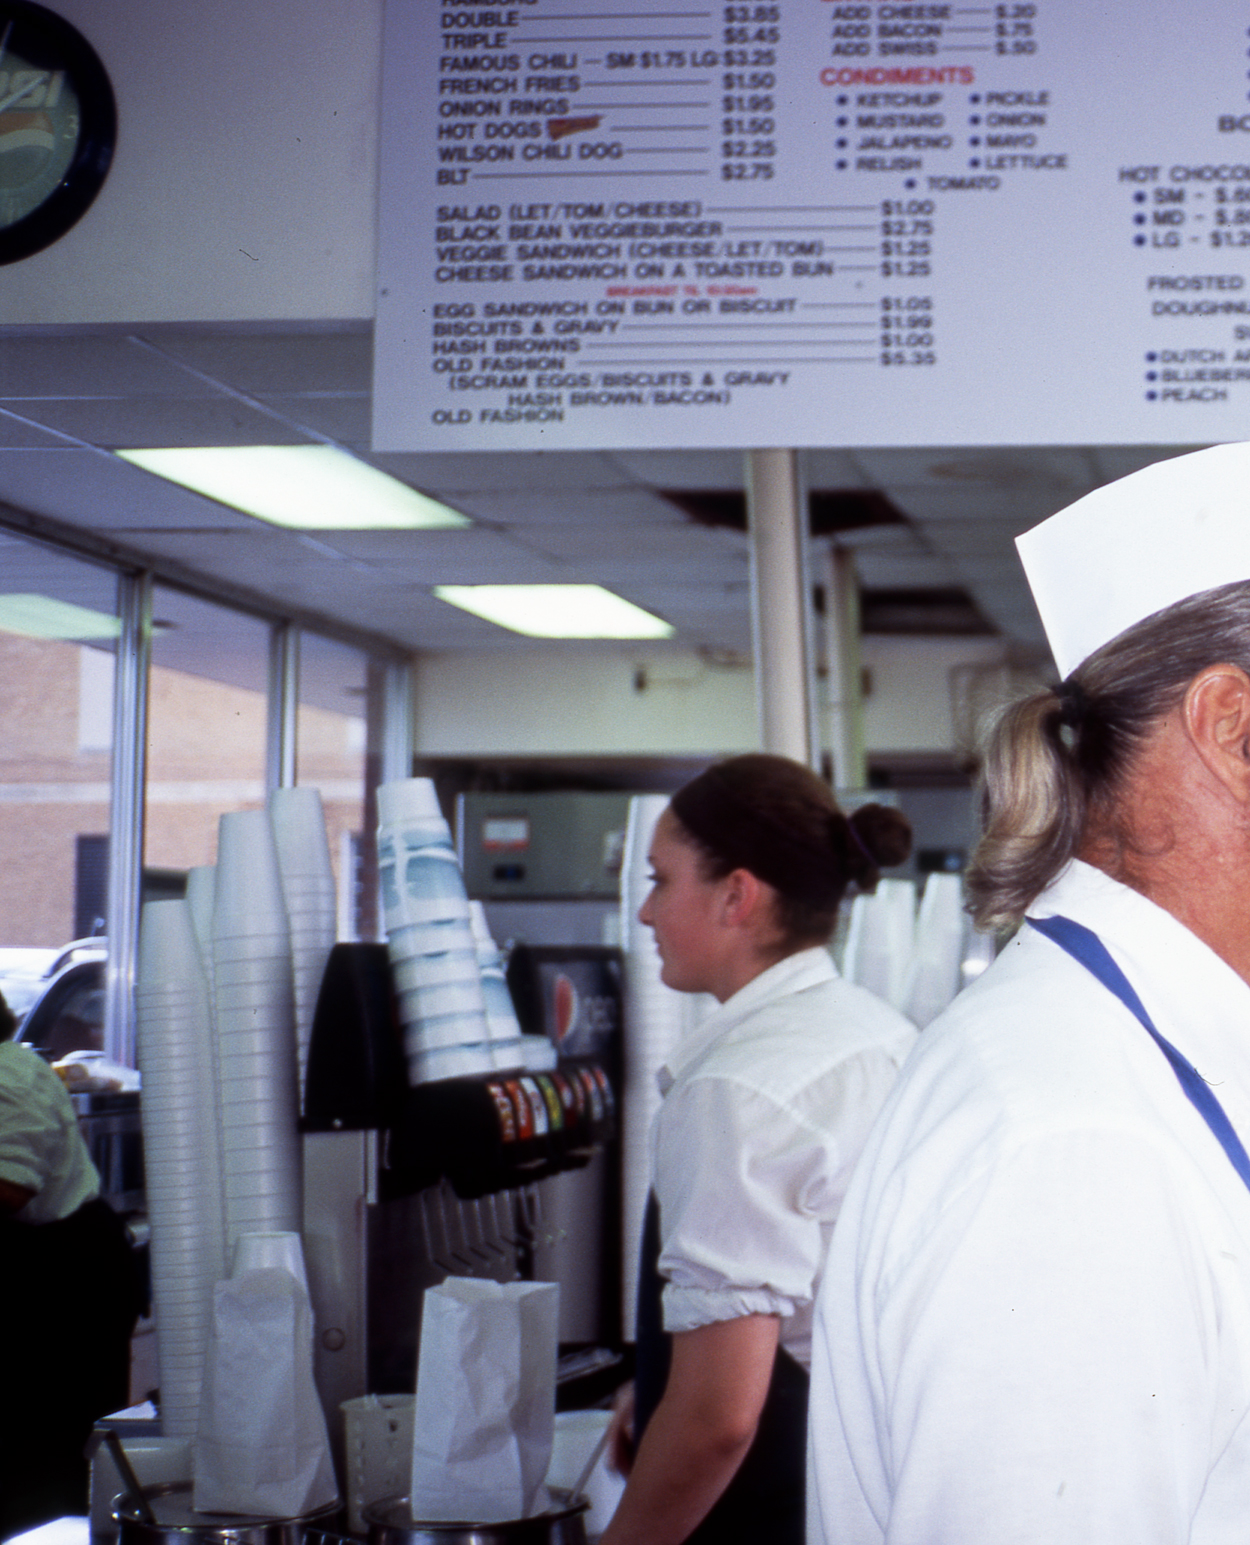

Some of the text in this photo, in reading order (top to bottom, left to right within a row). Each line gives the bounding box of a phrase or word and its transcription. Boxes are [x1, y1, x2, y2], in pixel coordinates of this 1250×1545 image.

[440, 11, 520, 28] DOUBLE
[441, 32, 507, 49] TRIPLE
[439, 54, 520, 72] FAMOUS
[527, 53, 577, 70] CHILI
[690, 49, 719, 68] LG
[438, 77, 517, 94] FRENCH
[524, 76, 581, 92] FRIES
[819, 66, 975, 86] CONDIMENTS
[438, 100, 501, 118] ONION
[508, 99, 570, 115] RINGS
[63, 115, 78, 139] 3
[985, 112, 1046, 127] ONION
[437, 122, 477, 140] HOT
[483, 121, 542, 139] DOGS
[438, 145, 515, 162] WILSON
[521, 143, 571, 161] CHILI
[578, 142, 623, 160] DOG
[436, 162, 775, 186] BLT $2.75
[927, 175, 1001, 191] TOMATO
[1118, 166, 1161, 183] HOT
[436, 205, 502, 222] SALAD
[880, 199, 935, 217] $1.00
[435, 226, 500, 242] BLACK
[508, 224, 562, 241] BEAN
[569, 221, 723, 239] VEGGIEBURGER
[436, 246, 507, 262] VEGGIE
[516, 243, 621, 260] SANDWICH
[434, 265, 513, 283] CHEESE
[522, 263, 628, 281] SANDWICH
[634, 263, 665, 279] ON
[671, 263, 686, 278] A
[694, 261, 785, 279] TOASTED
[791, 260, 835, 277] BUN
[1146, 275, 1245, 292] FROSTED
[432, 302, 476, 319] EGG
[483, 301, 588, 317] SANDWICH
[595, 300, 625, 315] ON
[632, 300, 675, 315] BUN
[681, 299, 711, 314] OR
[718, 298, 797, 314] BISCUIT
[432, 321, 523, 337] BISCUITS
[553, 319, 619, 335] GRAVY
[432, 340, 487, 355] HASH
[493, 338, 581, 354] BROWNS
[431, 356, 565, 374] OLD FASHION
[1161, 349, 1226, 364] DUTCH
[723, 371, 790, 387] GRAVY
[507, 392, 562, 408] HASH
[1161, 387, 1228, 403] PEACH
[431, 405, 564, 425] OLD FASHION
